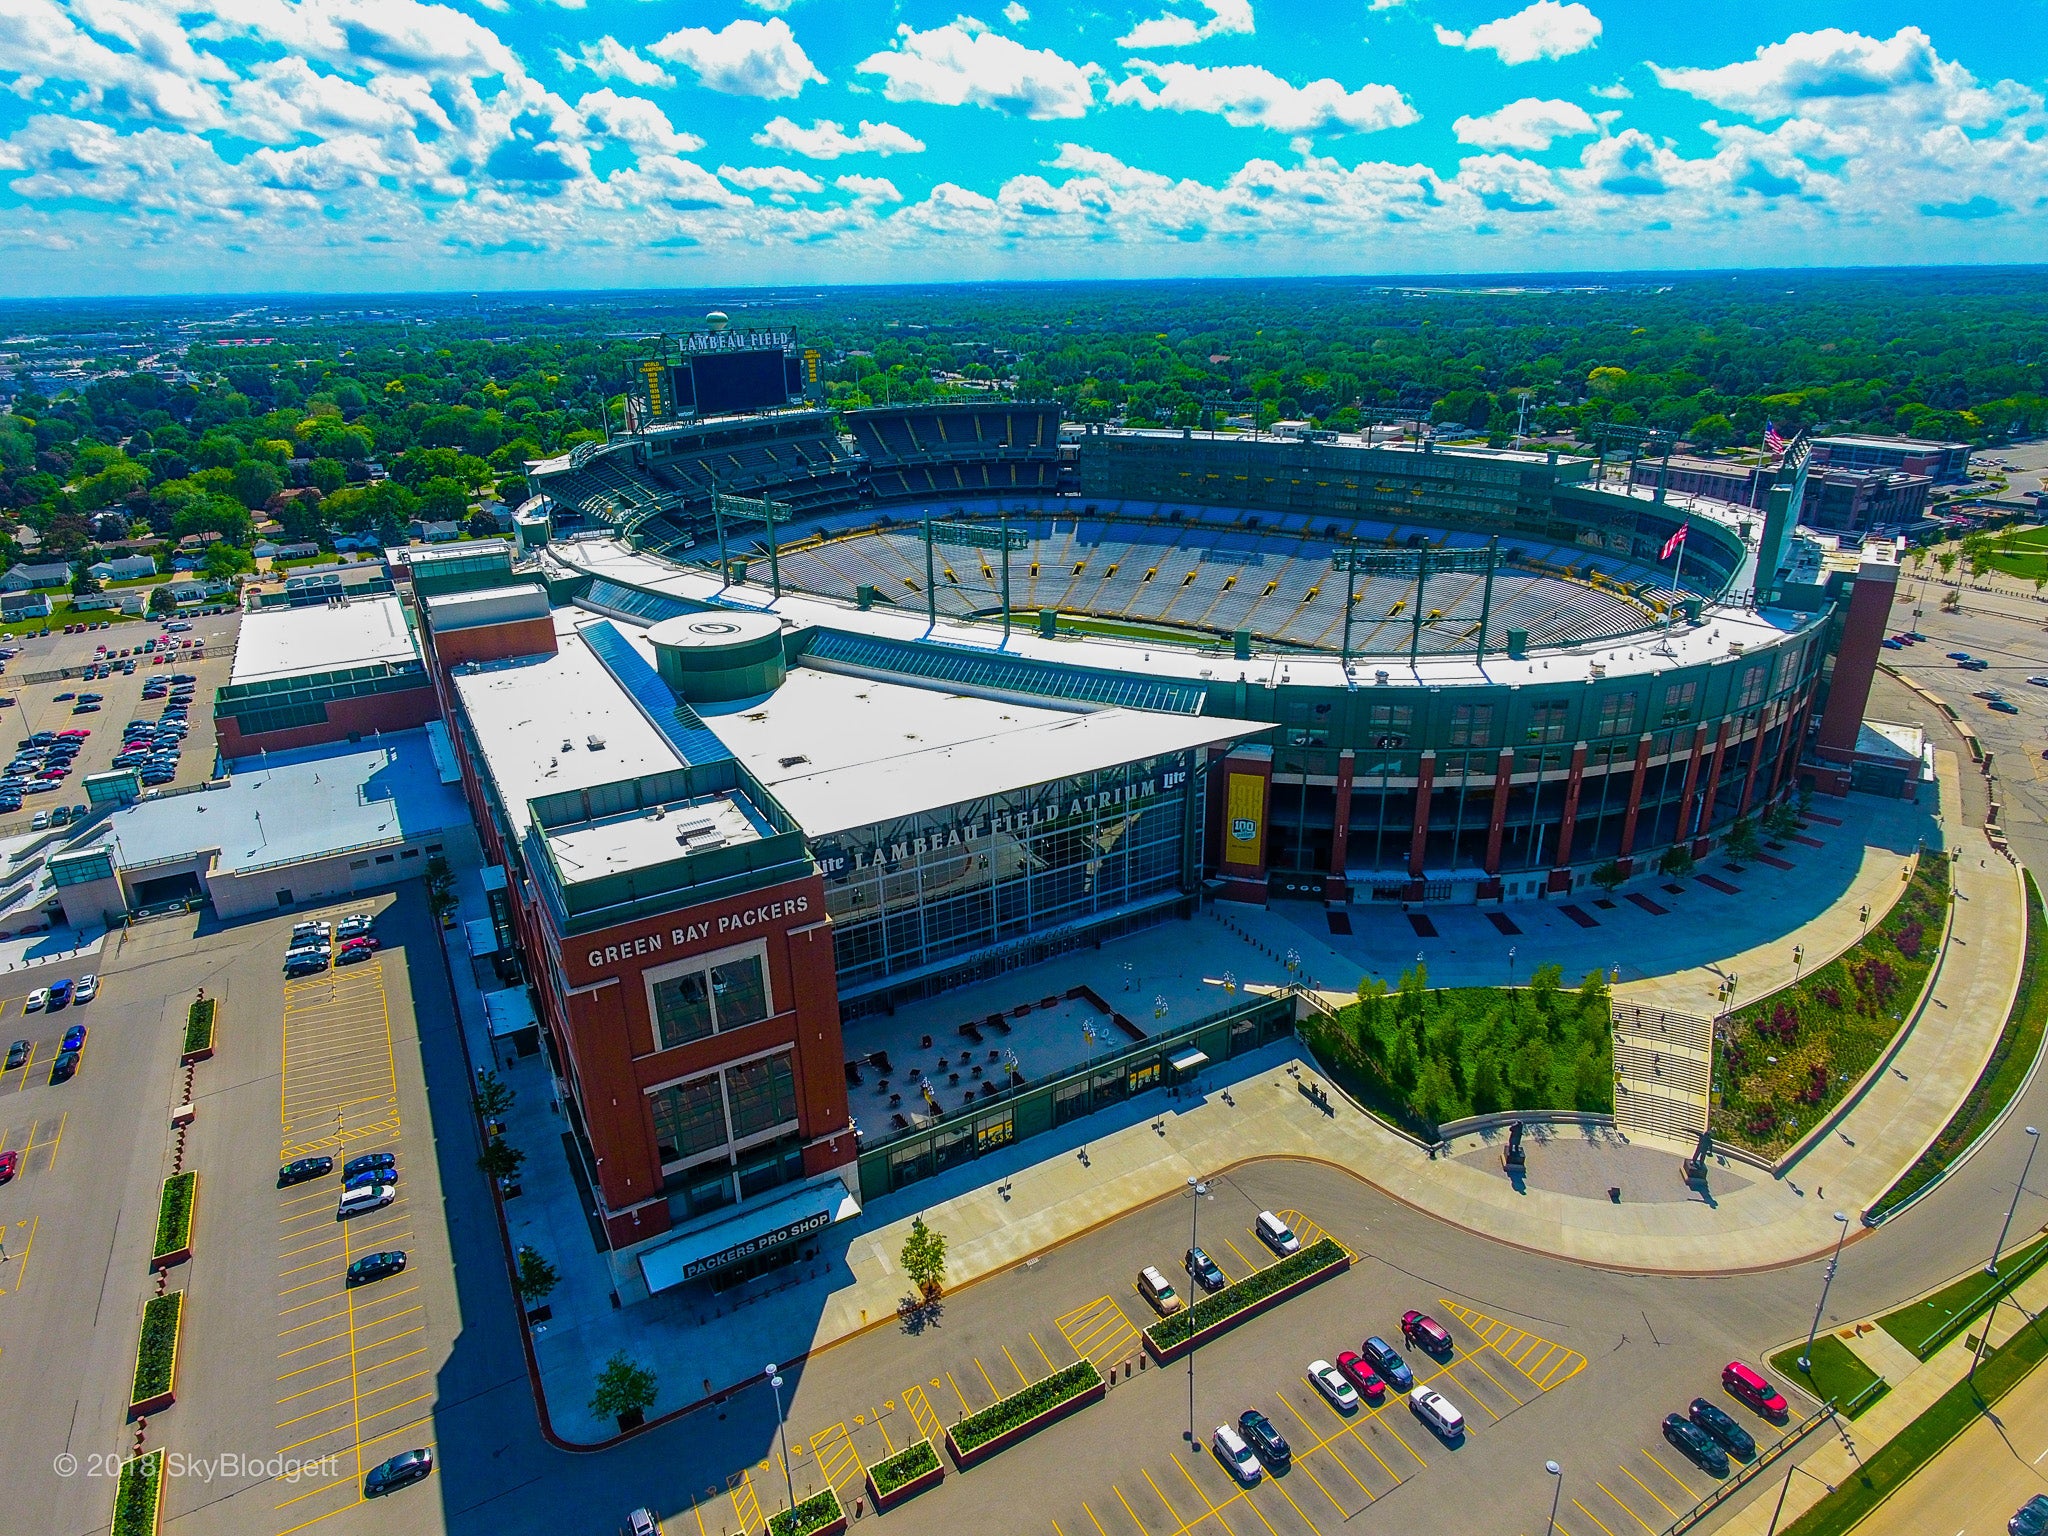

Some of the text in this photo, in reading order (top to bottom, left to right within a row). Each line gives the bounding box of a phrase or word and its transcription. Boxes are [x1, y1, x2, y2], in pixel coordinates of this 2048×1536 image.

[679, 332, 788, 352] LAMBEAU FIELD
[1163, 771, 1186, 788] Lite
[855, 779, 1156, 871] LAMBEAU FIELD ATRIUM
[1235, 821, 1254, 832] 100
[588, 896, 810, 968] GREEN BAY PACKERS
[687, 1213, 830, 1278] PACKERS PRO SHOP
